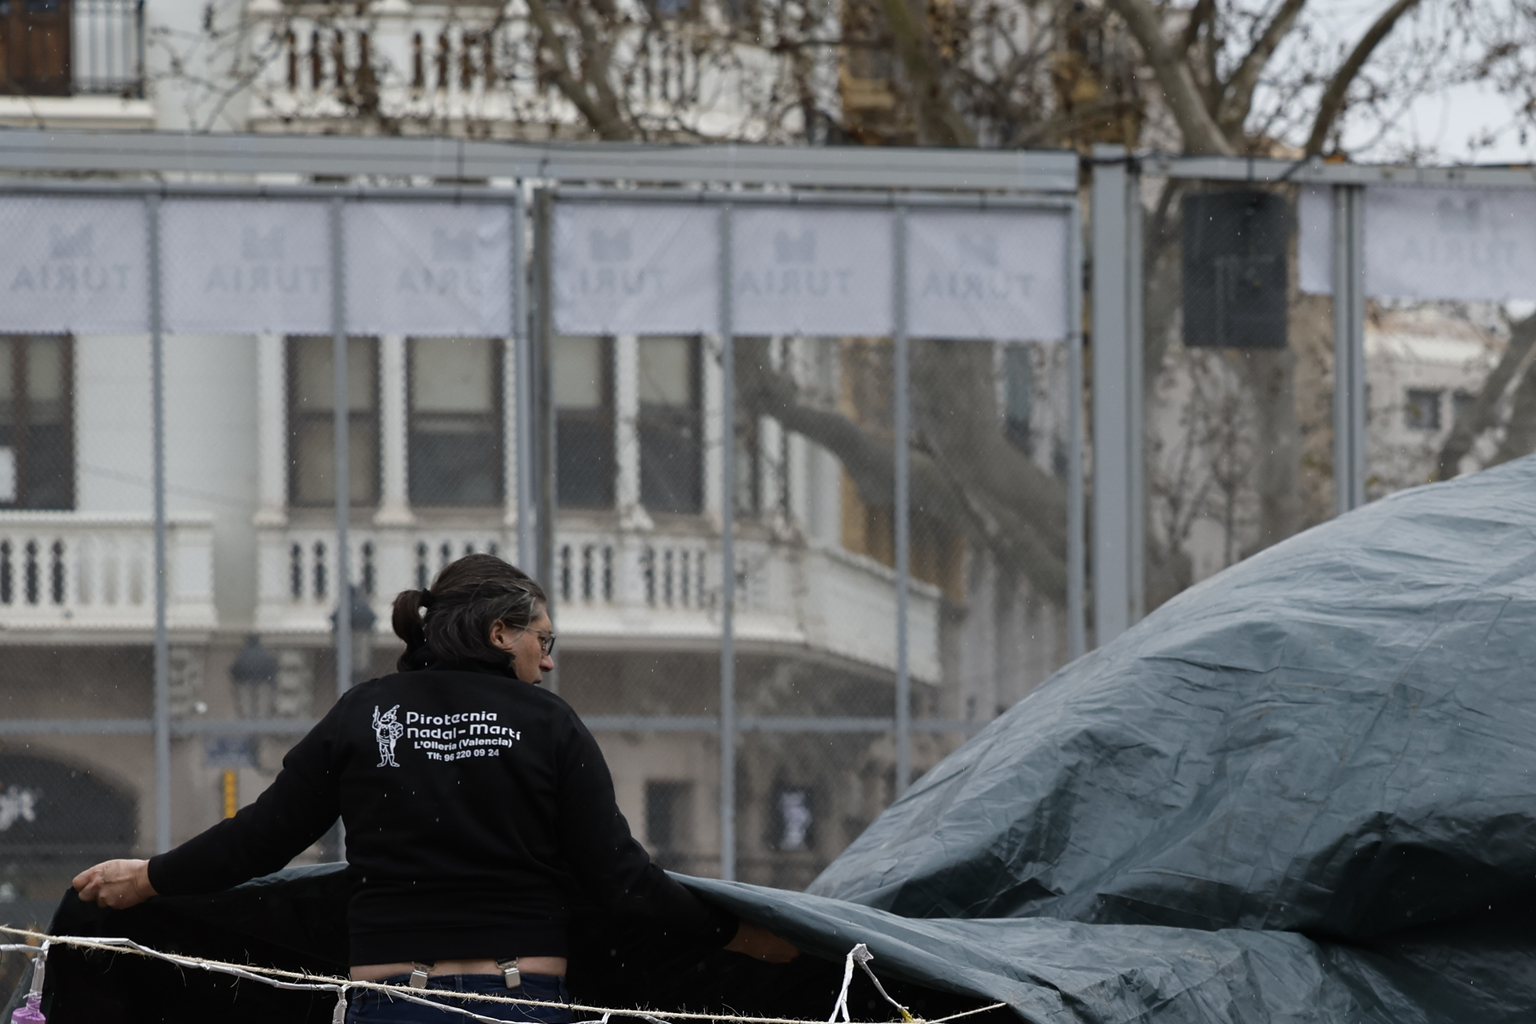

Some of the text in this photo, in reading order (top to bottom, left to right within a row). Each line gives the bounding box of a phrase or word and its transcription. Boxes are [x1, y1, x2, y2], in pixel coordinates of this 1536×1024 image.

[406, 711, 498, 725] Pirotecnia
[458, 737, 513, 749] (Valencia)
[443, 753, 455, 762] 96
[456, 749, 472, 760] 220
[473, 748, 486, 757] 09
[487, 748, 500, 757] 24
